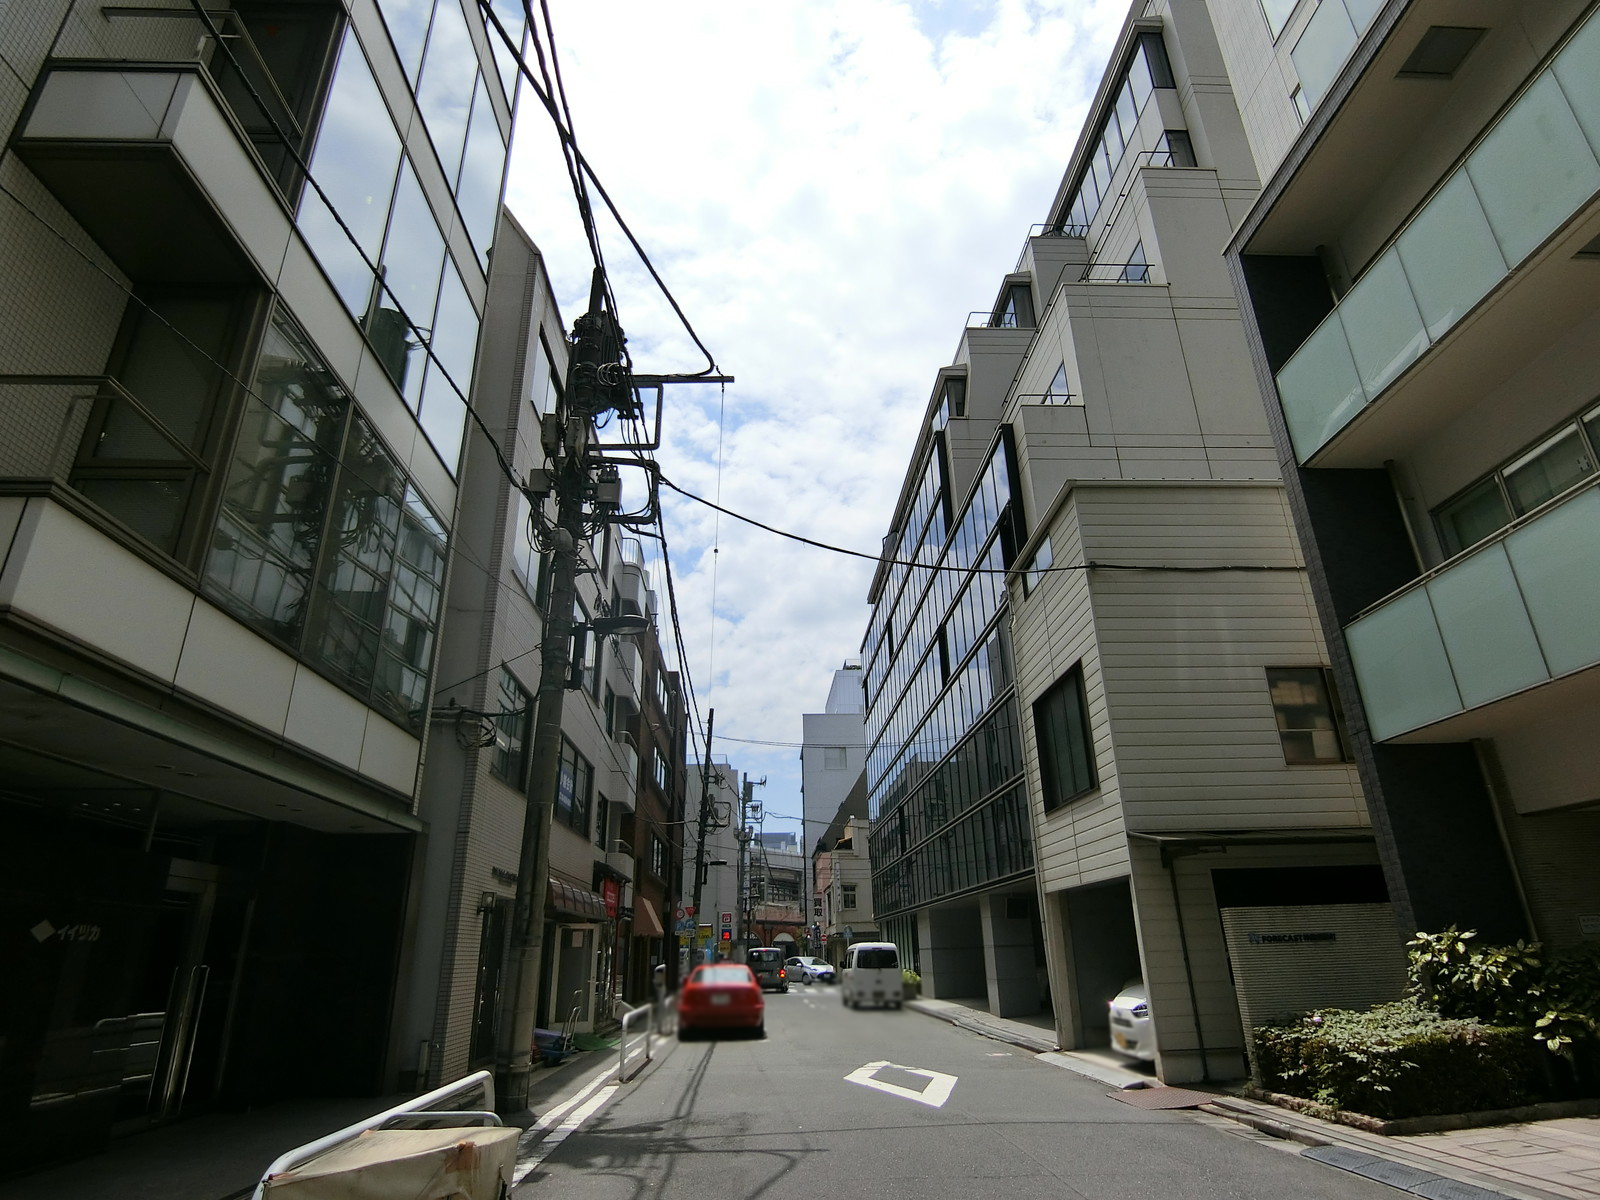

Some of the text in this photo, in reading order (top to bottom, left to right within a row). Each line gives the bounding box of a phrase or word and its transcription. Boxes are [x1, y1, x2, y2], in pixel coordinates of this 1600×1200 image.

[813, 897, 823, 917] 買取
[57, 924, 101, 941] イイツカ
[1262, 935, 1302, 943] FORECAST
